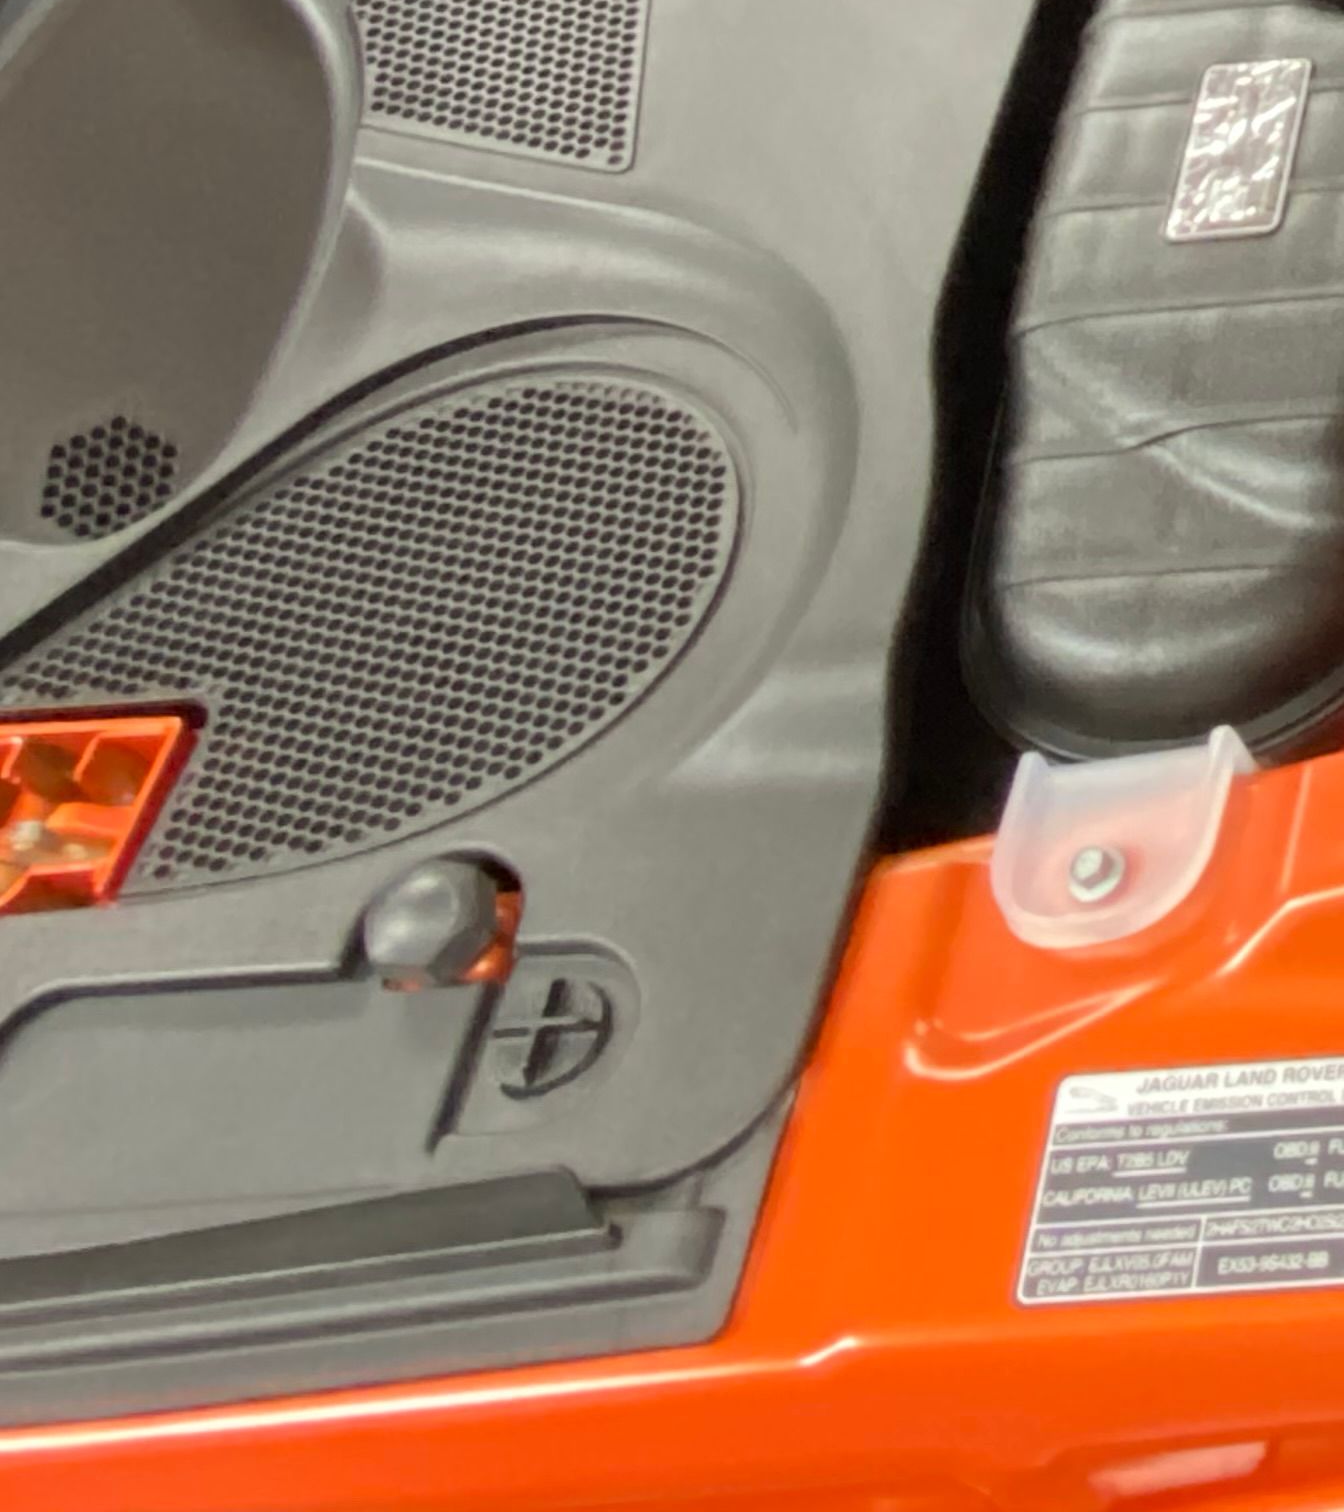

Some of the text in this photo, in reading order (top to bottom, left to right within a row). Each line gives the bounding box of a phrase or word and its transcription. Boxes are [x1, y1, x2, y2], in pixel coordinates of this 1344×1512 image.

[1135, 1072, 1219, 1094] JAGUAR
[1223, 1068, 1278, 1088] LAND
[1126, 1099, 1188, 1116] VEHICLE
[1192, 1094, 1262, 1111] EMISSION
[1266, 1089, 1335, 1107] CONTROL
[1054, 1124, 1126, 1142] Conforms
[1127, 1123, 1143, 1138] to
[1049, 1157, 1073, 1175] US
